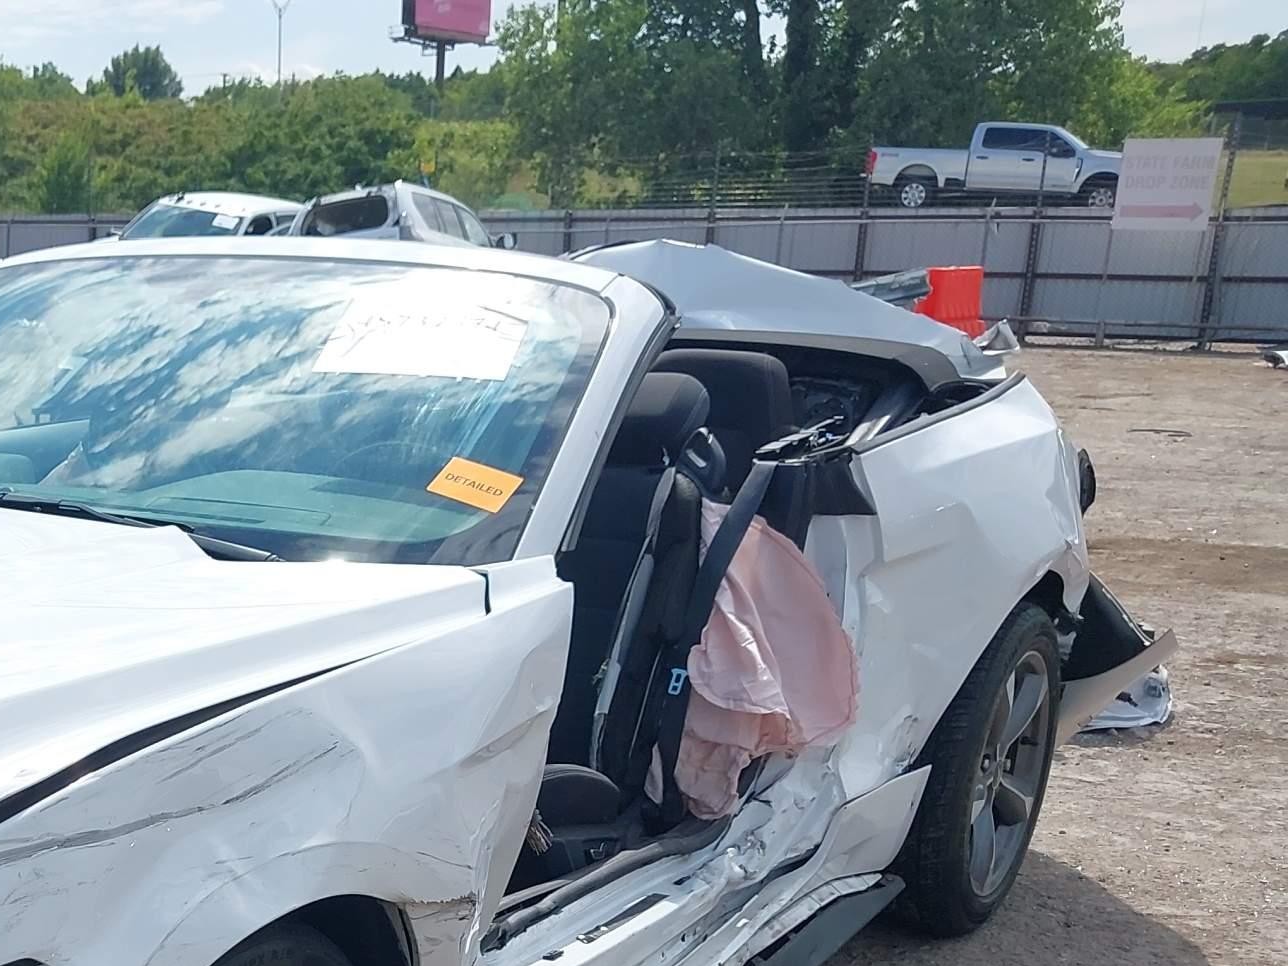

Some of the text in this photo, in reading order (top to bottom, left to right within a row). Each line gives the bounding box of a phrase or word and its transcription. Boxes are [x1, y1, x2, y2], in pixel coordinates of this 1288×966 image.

[1125, 155, 1216, 169] STATE FARM
[1124, 175, 1210, 190] DROP ZONE
[445, 472, 504, 497] DETAILED
